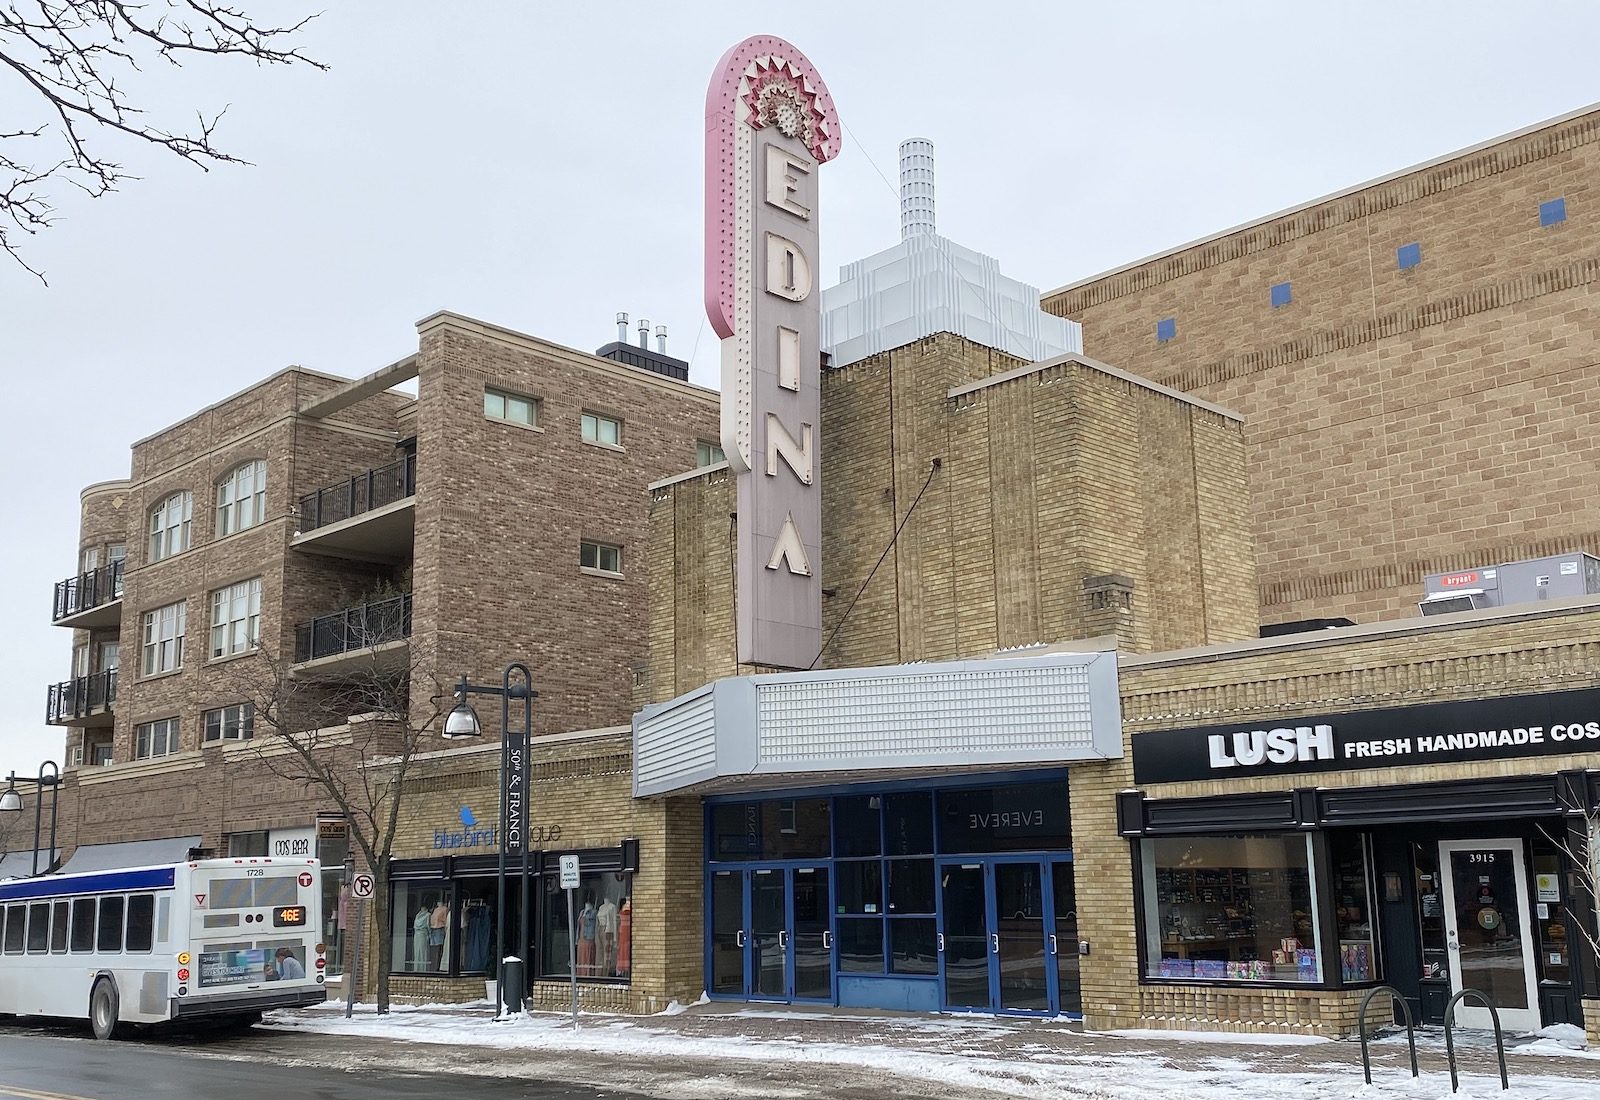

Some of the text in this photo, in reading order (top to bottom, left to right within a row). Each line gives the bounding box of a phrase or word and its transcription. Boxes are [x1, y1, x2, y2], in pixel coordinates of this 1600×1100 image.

[765, 142, 812, 577] EDINA
[1447, 575, 1472, 585] bryant
[1208, 724, 1335, 768] LUSH
[1344, 721, 1600, 758] FRESH HANDMADE COS
[509, 748, 522, 848] 50th & FRANCE
[275, 838, 309, 856] COS BAR
[565, 861, 574, 869] 10
[1469, 853, 1495, 863] 3915
[246, 869, 264, 877] 1728
[280, 909, 300, 922] 46E
